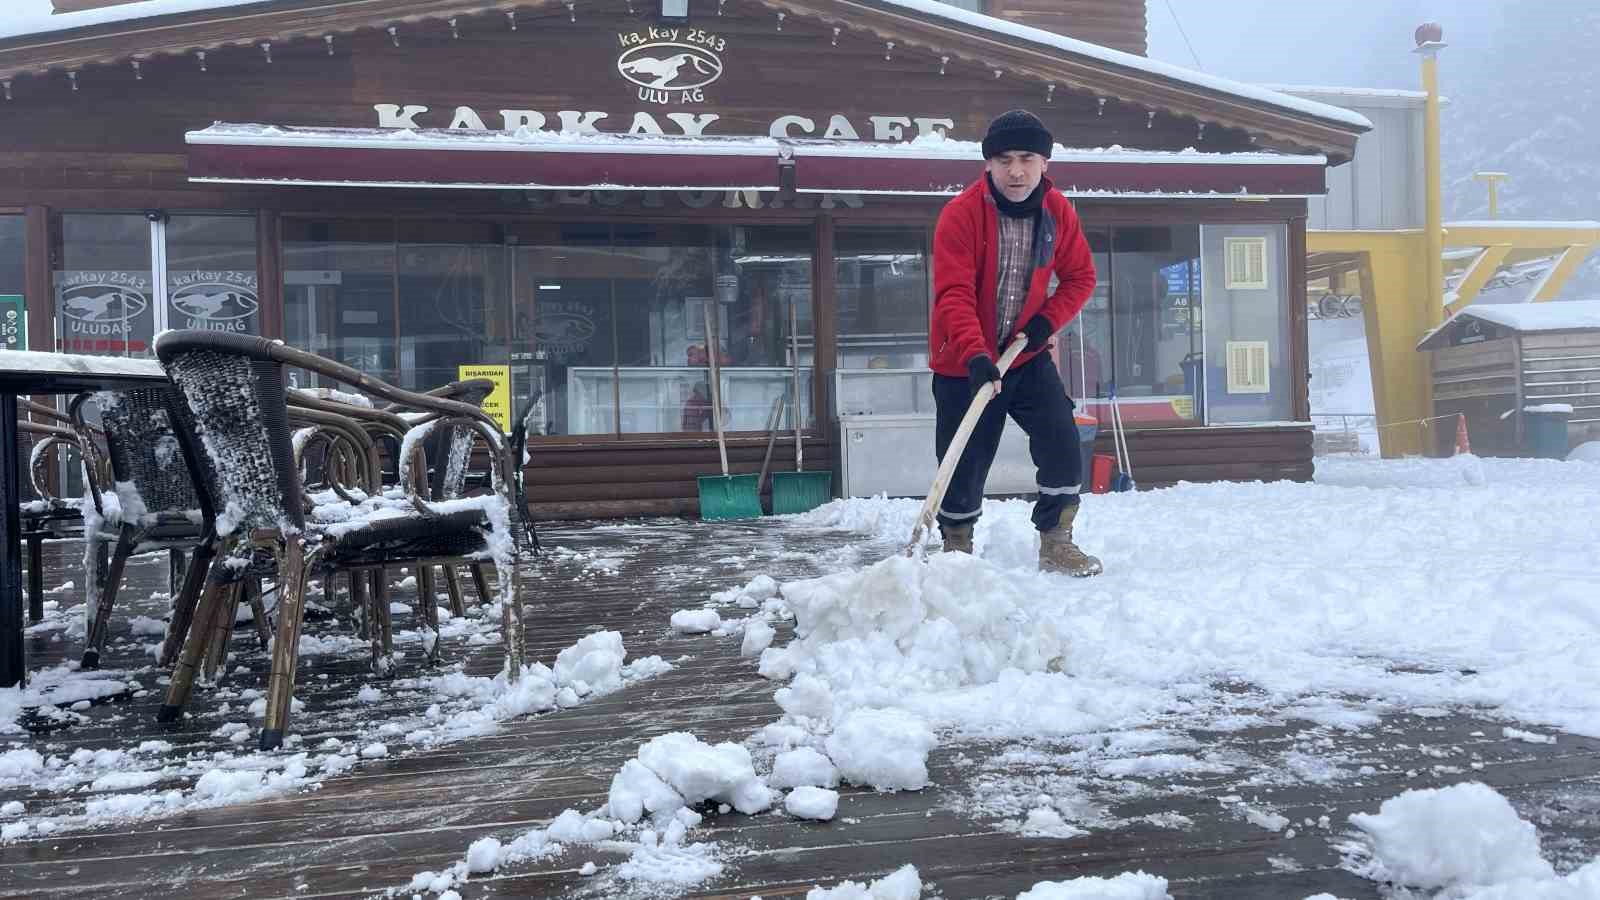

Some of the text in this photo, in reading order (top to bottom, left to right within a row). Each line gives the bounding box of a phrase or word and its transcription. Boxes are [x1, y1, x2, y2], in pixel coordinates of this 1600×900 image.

[686, 28, 726, 52] 2543
[374, 103, 954, 141] KARKAY CAFE
[110, 271, 146, 289] 2543
[174, 269, 222, 287] karkay
